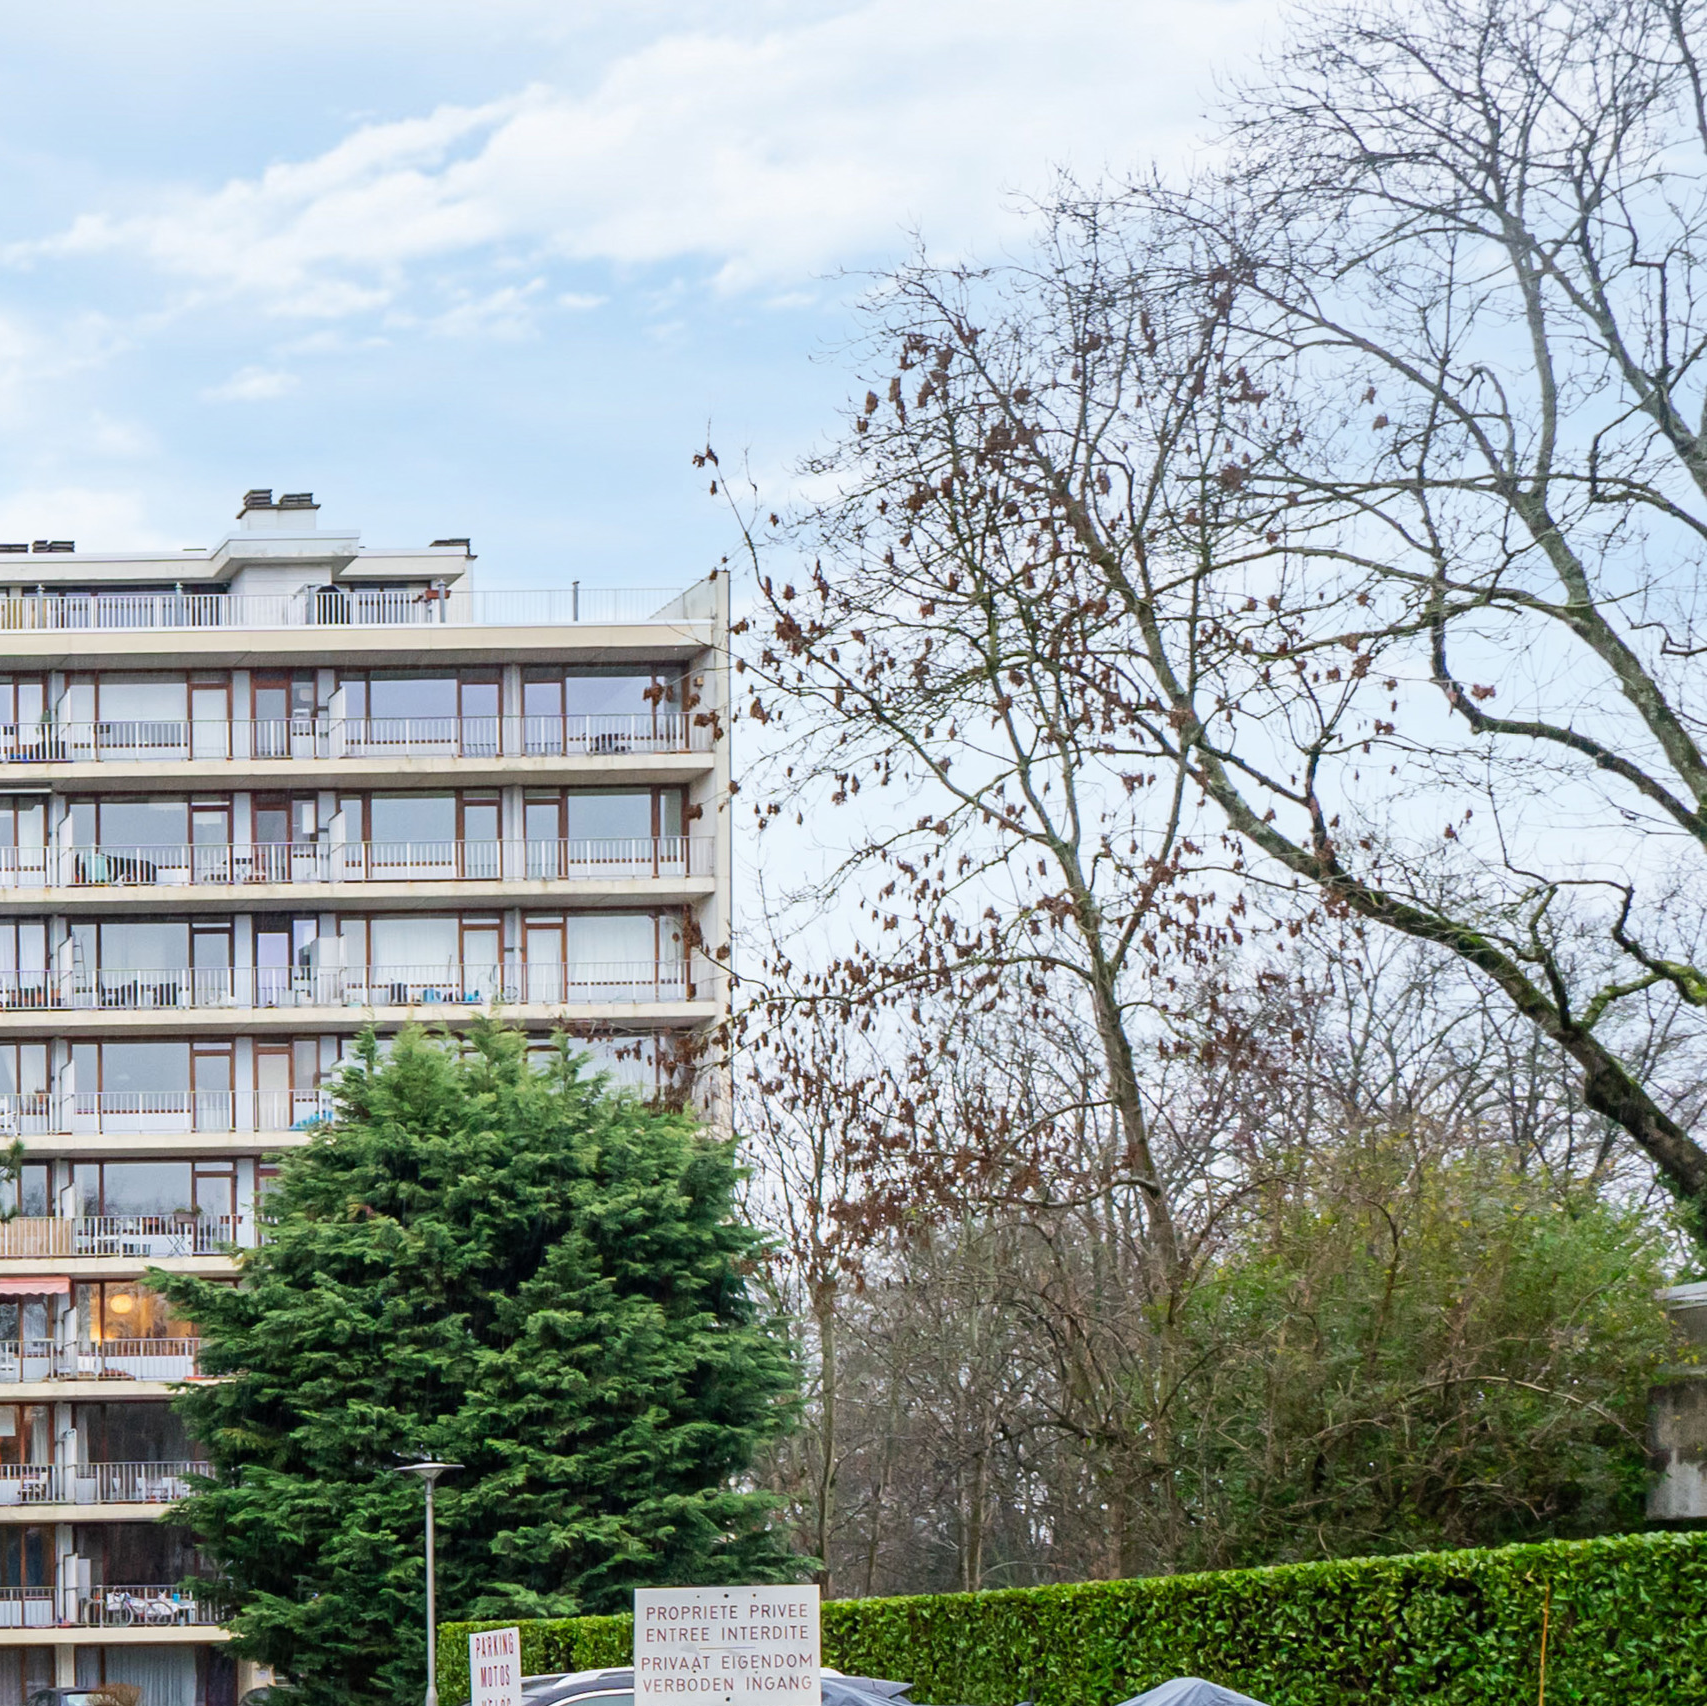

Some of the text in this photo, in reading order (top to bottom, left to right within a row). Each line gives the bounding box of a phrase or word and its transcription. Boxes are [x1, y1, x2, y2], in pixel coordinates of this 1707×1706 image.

[646, 1603, 808, 1621] PROPRIETE PRIVEE
[646, 1625, 809, 1642] ENTREE INTERDITE
[475, 1632, 514, 1659] PARKING
[641, 1653, 813, 1671] PRIVAAT EIGENDOM
[480, 1664, 510, 1688] MOTOS
[642, 1675, 812, 1693] VERBODEN INGANG
